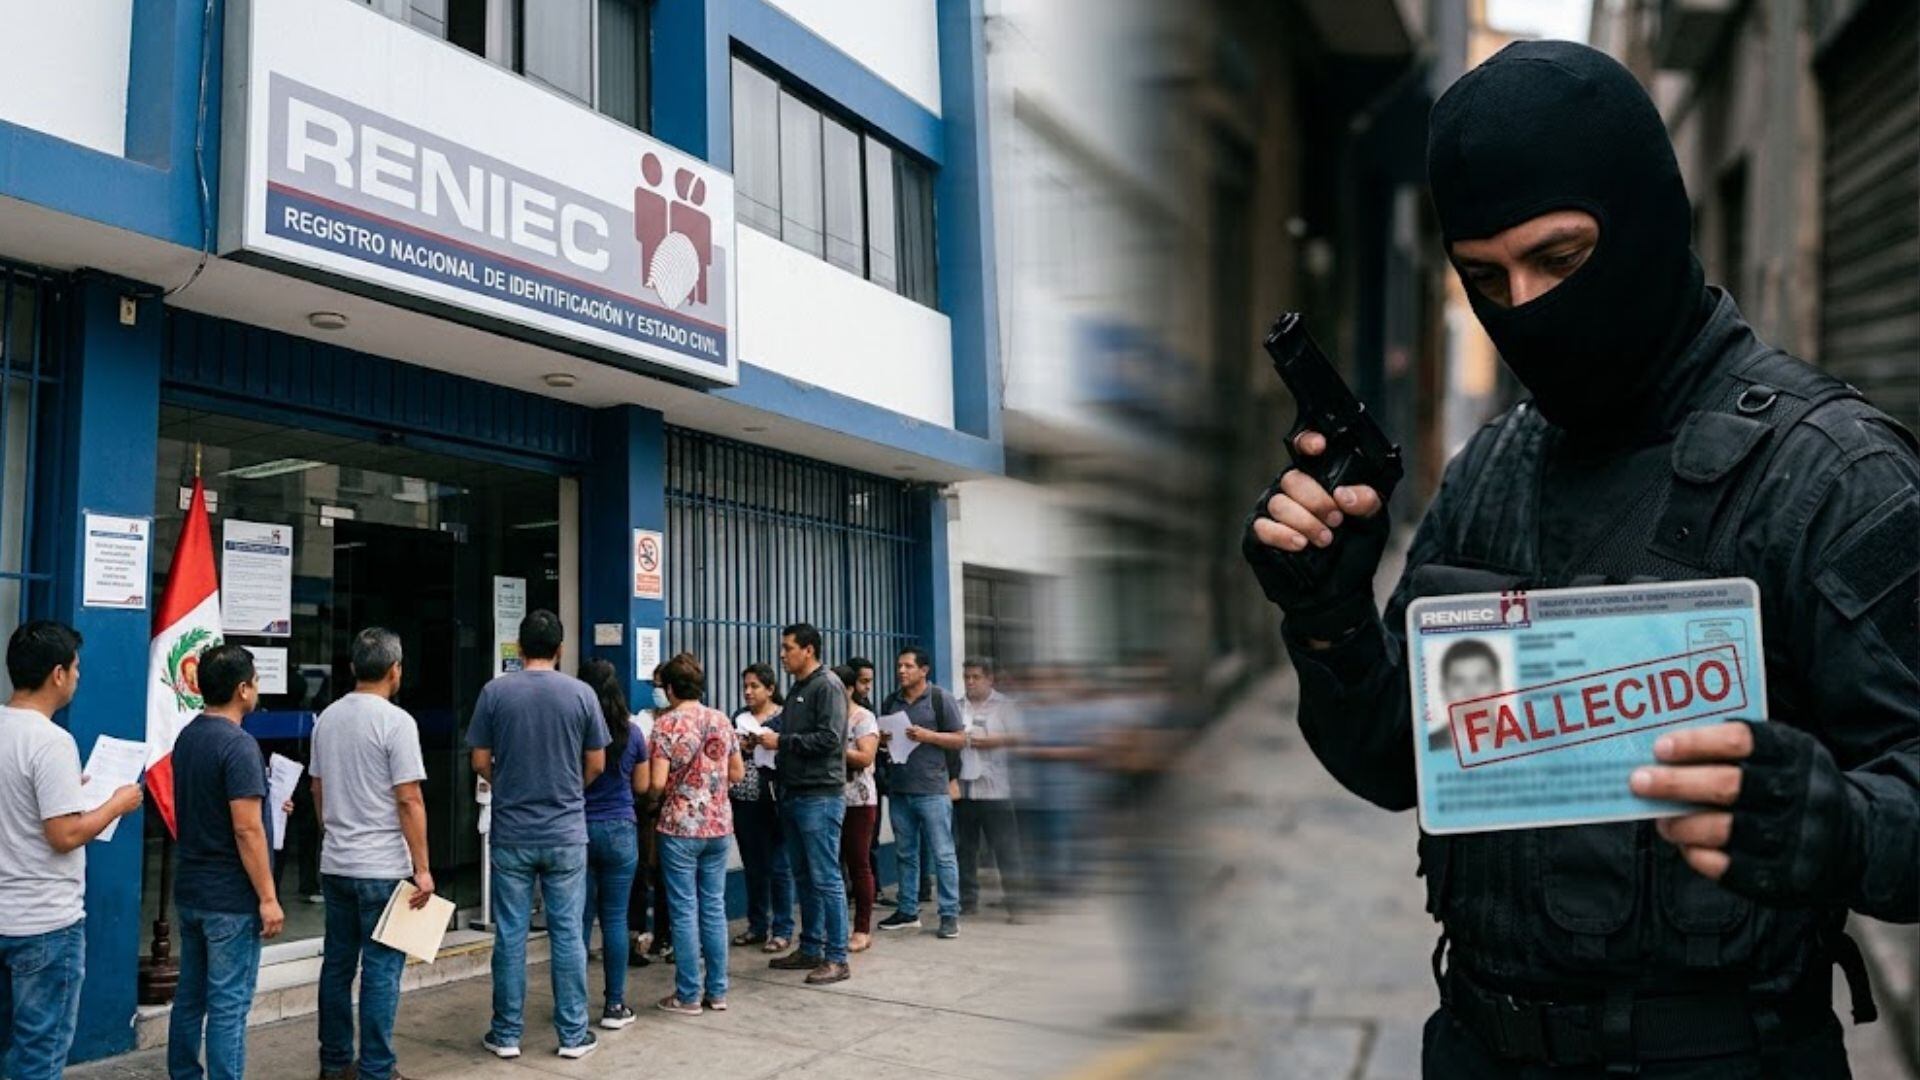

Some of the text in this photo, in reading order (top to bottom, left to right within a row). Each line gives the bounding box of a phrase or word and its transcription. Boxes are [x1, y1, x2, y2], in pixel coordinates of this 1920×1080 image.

[286, 96, 610, 273] RENIEC
[284, 206, 720, 356] REGISTRO NACIONAL DE IDENTIFICACIÓN Y ESTADO CIVIL
[1421, 608, 1495, 626] RENIEC
[1464, 659, 1732, 754] FALLECIDO
